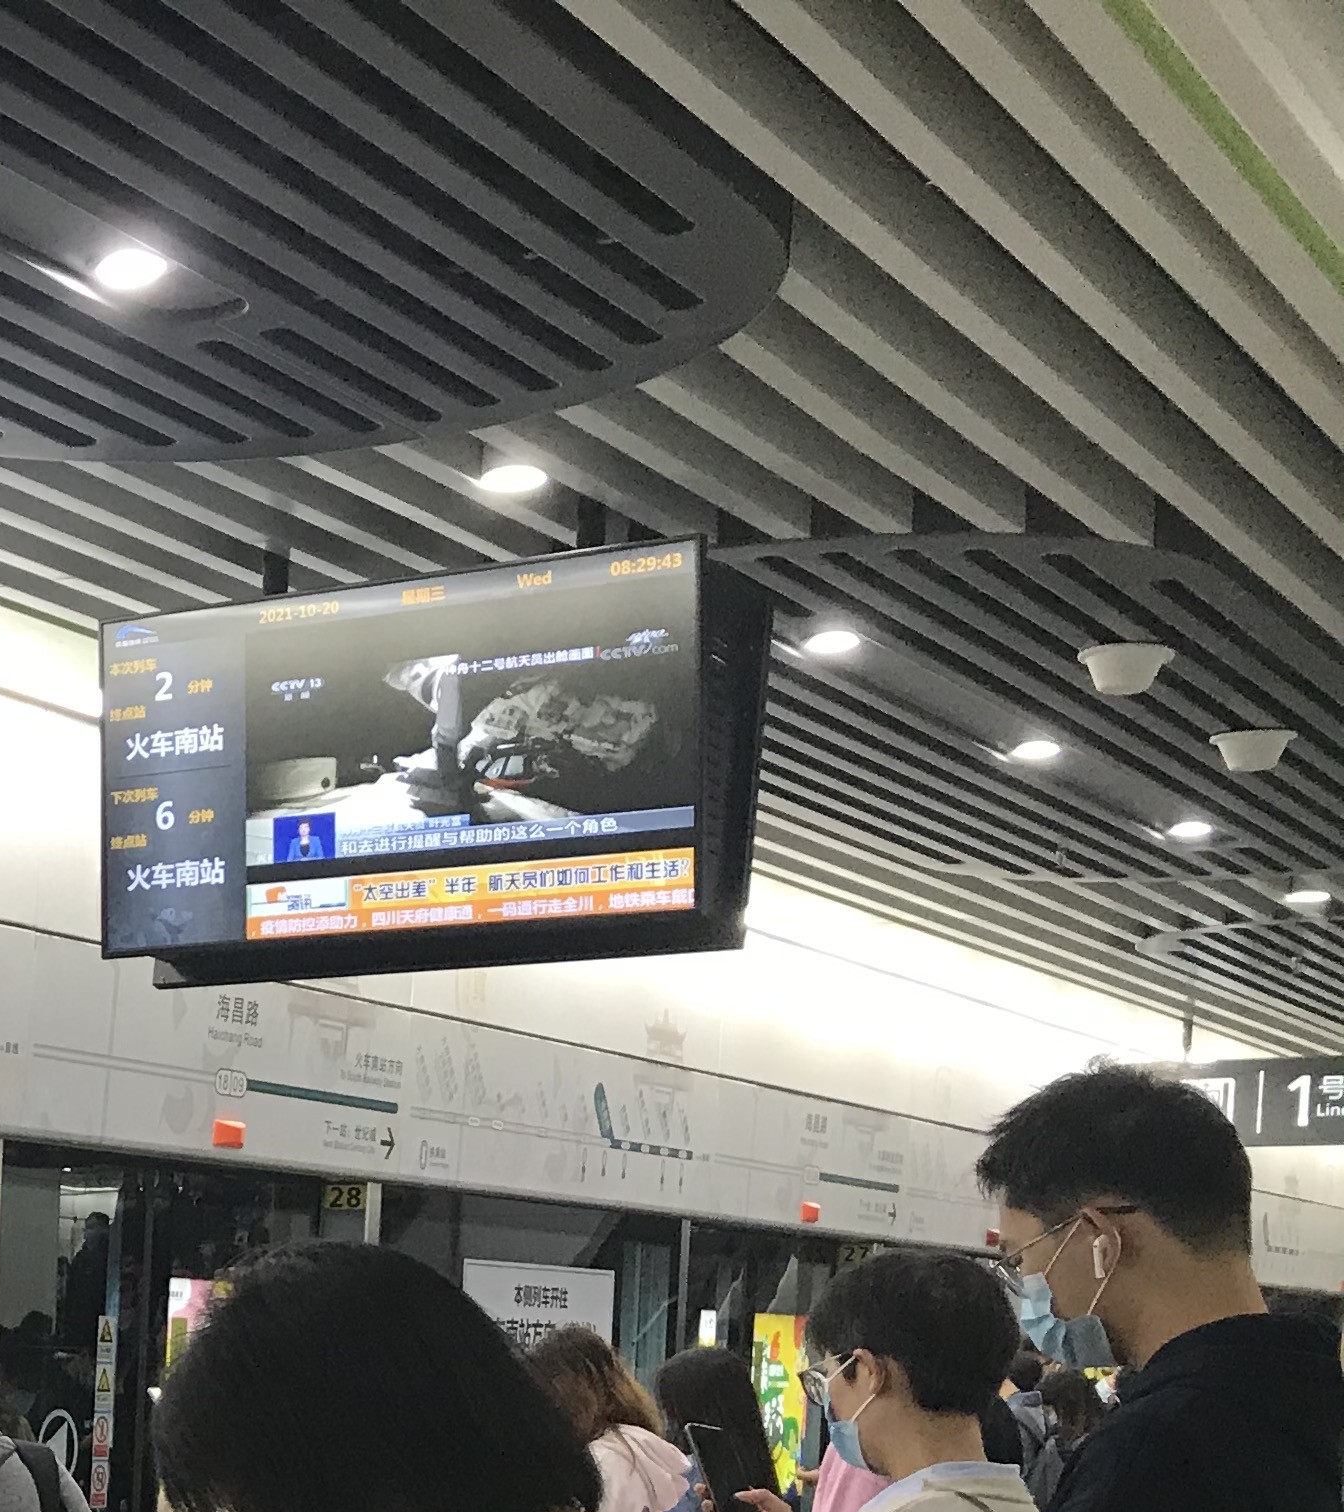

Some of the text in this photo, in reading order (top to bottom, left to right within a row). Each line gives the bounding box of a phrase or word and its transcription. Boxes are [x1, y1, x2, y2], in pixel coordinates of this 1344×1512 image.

[258, 552, 683, 624] 2021-10-20 星期三 Wed 08:29:43
[154, 672, 213, 701] 2 分钟
[271, 678, 305, 693] CCTV
[126, 723, 224, 762] 火车南站
[111, 787, 159, 805] 下次列车
[155, 800, 214, 830] 6 分钟
[126, 856, 226, 892] 火车南站
[215, 993, 260, 1027] 海昌路
[329, 1186, 362, 1209] 28
